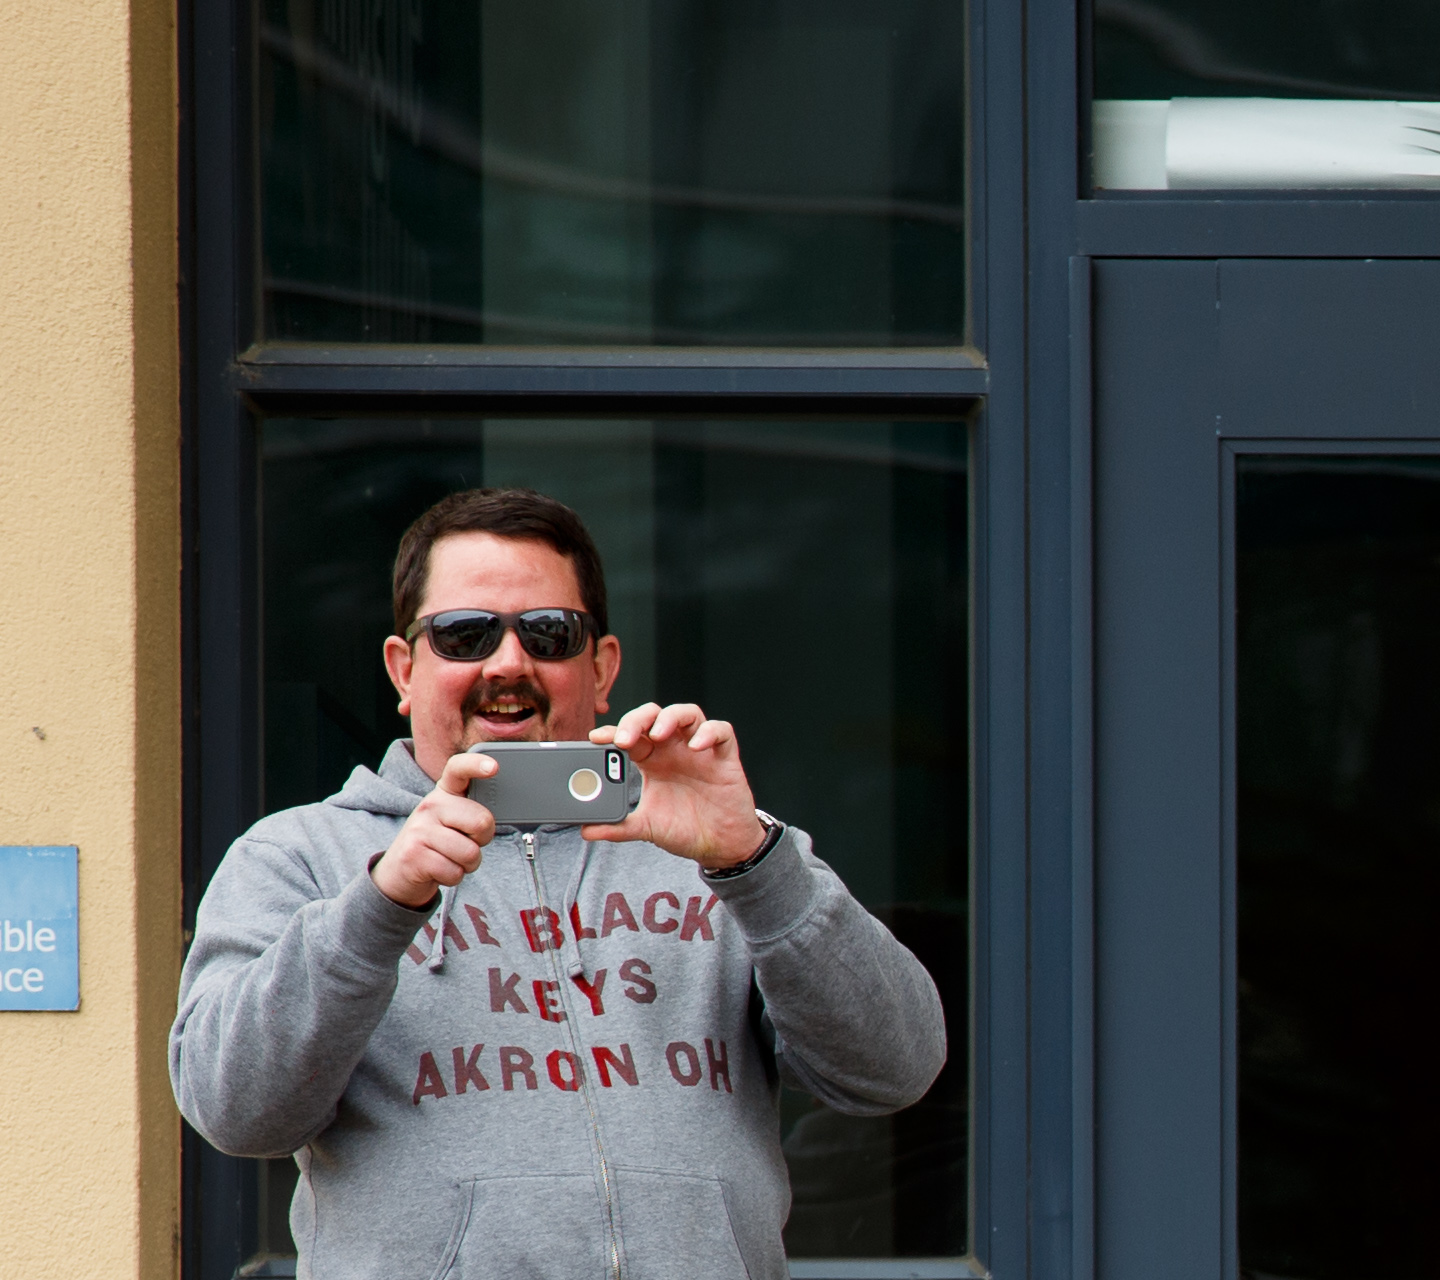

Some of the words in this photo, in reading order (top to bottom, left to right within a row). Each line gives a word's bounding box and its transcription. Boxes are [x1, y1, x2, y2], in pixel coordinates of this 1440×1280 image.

[519, 891, 720, 953] BLACK
[487, 958, 658, 1024] KEYS
[412, 1043, 640, 1106] AKRON
[665, 1038, 733, 1093] OH
